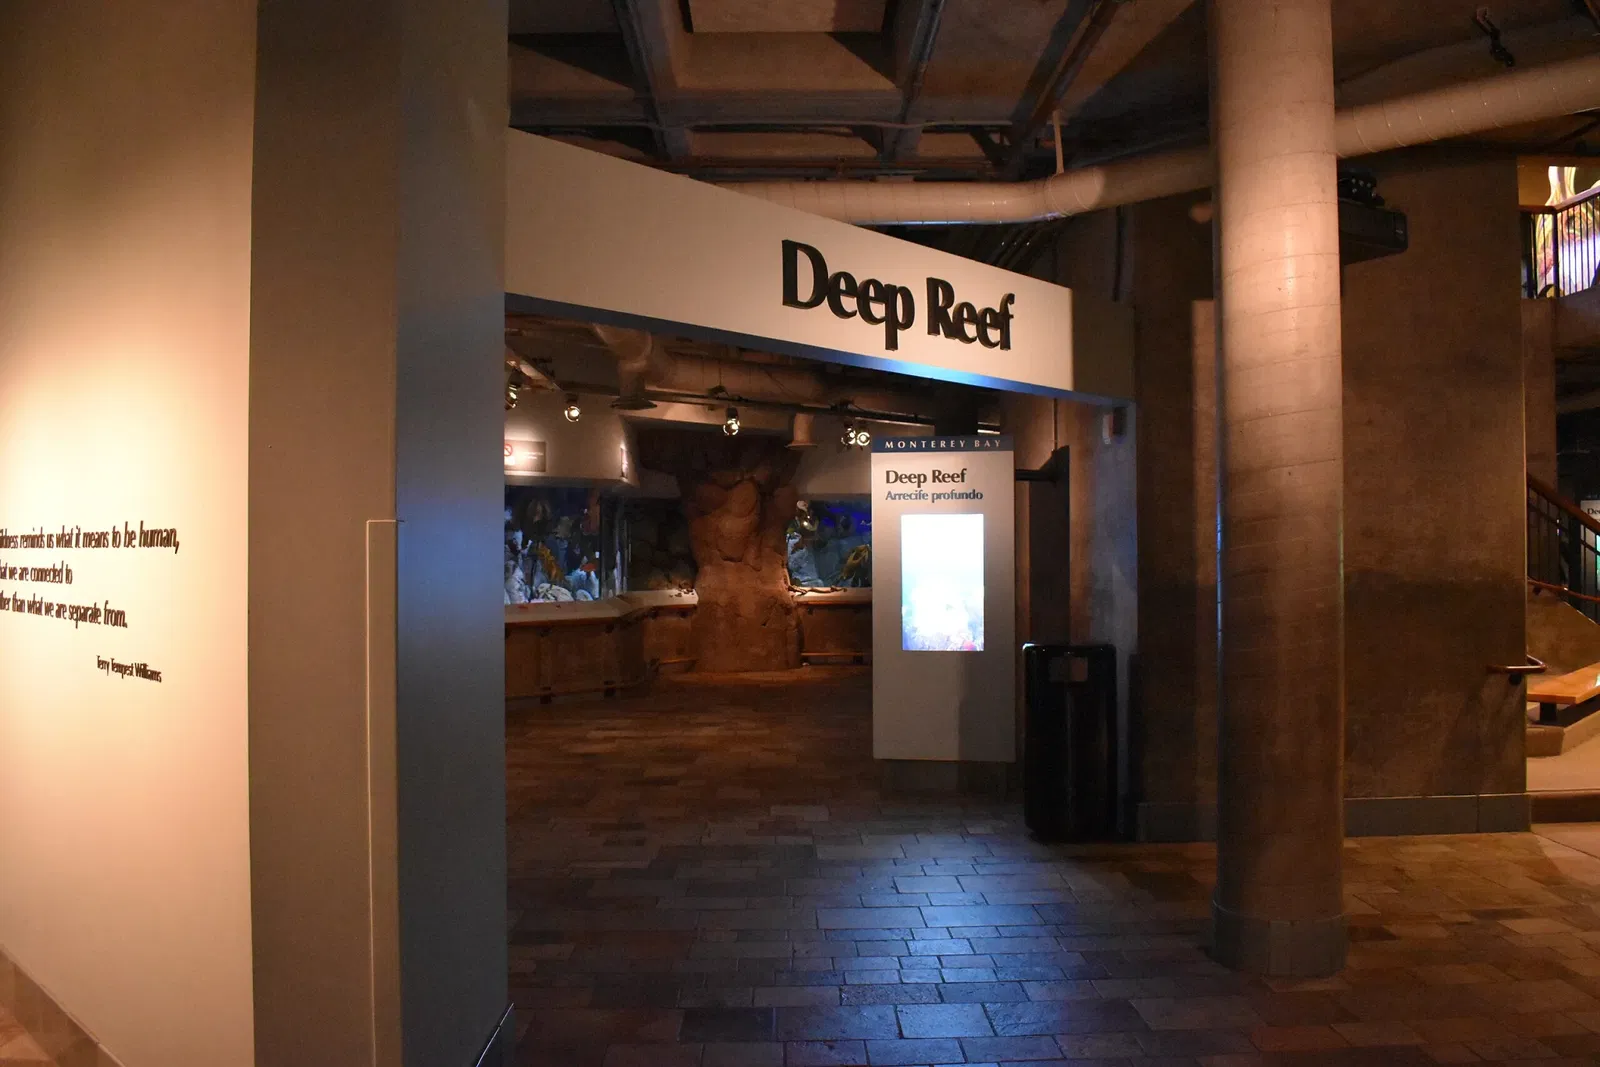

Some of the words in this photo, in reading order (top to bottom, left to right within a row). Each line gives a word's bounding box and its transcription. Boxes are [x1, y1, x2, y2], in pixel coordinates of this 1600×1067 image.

[782, 239, 915, 351] Deep
[926, 277, 1015, 351] Reef
[885, 440, 966, 449] MONTEREY
[974, 440, 1001, 448] BAY
[885, 469, 927, 488] Deep
[932, 468, 967, 484] Reef
[885, 489, 928, 501] Arrecife
[932, 489, 984, 503] profundo
[20, 527, 45, 549] reminds
[46, 533, 54, 549] us
[56, 525, 73, 549] what
[75, 525, 81, 549] it
[82, 531, 109, 549] means
[112, 525, 121, 549] to
[124, 521, 136, 549] be
[139, 520, 179, 554] human,
[9, 566, 18, 581] we
[19, 566, 29, 581] are
[30, 560, 64, 584] connected
[65, 564, 73, 585] to
[12, 591, 25, 613] than
[27, 593, 43, 616] what
[44, 601, 54, 617] we
[55, 602, 67, 620] are
[68, 602, 101, 629] separate
[104, 600, 128, 628] from.
[96, 655, 110, 676] Terry
[110, 658, 134, 679] Tempest
[134, 662, 162, 683] Williams
